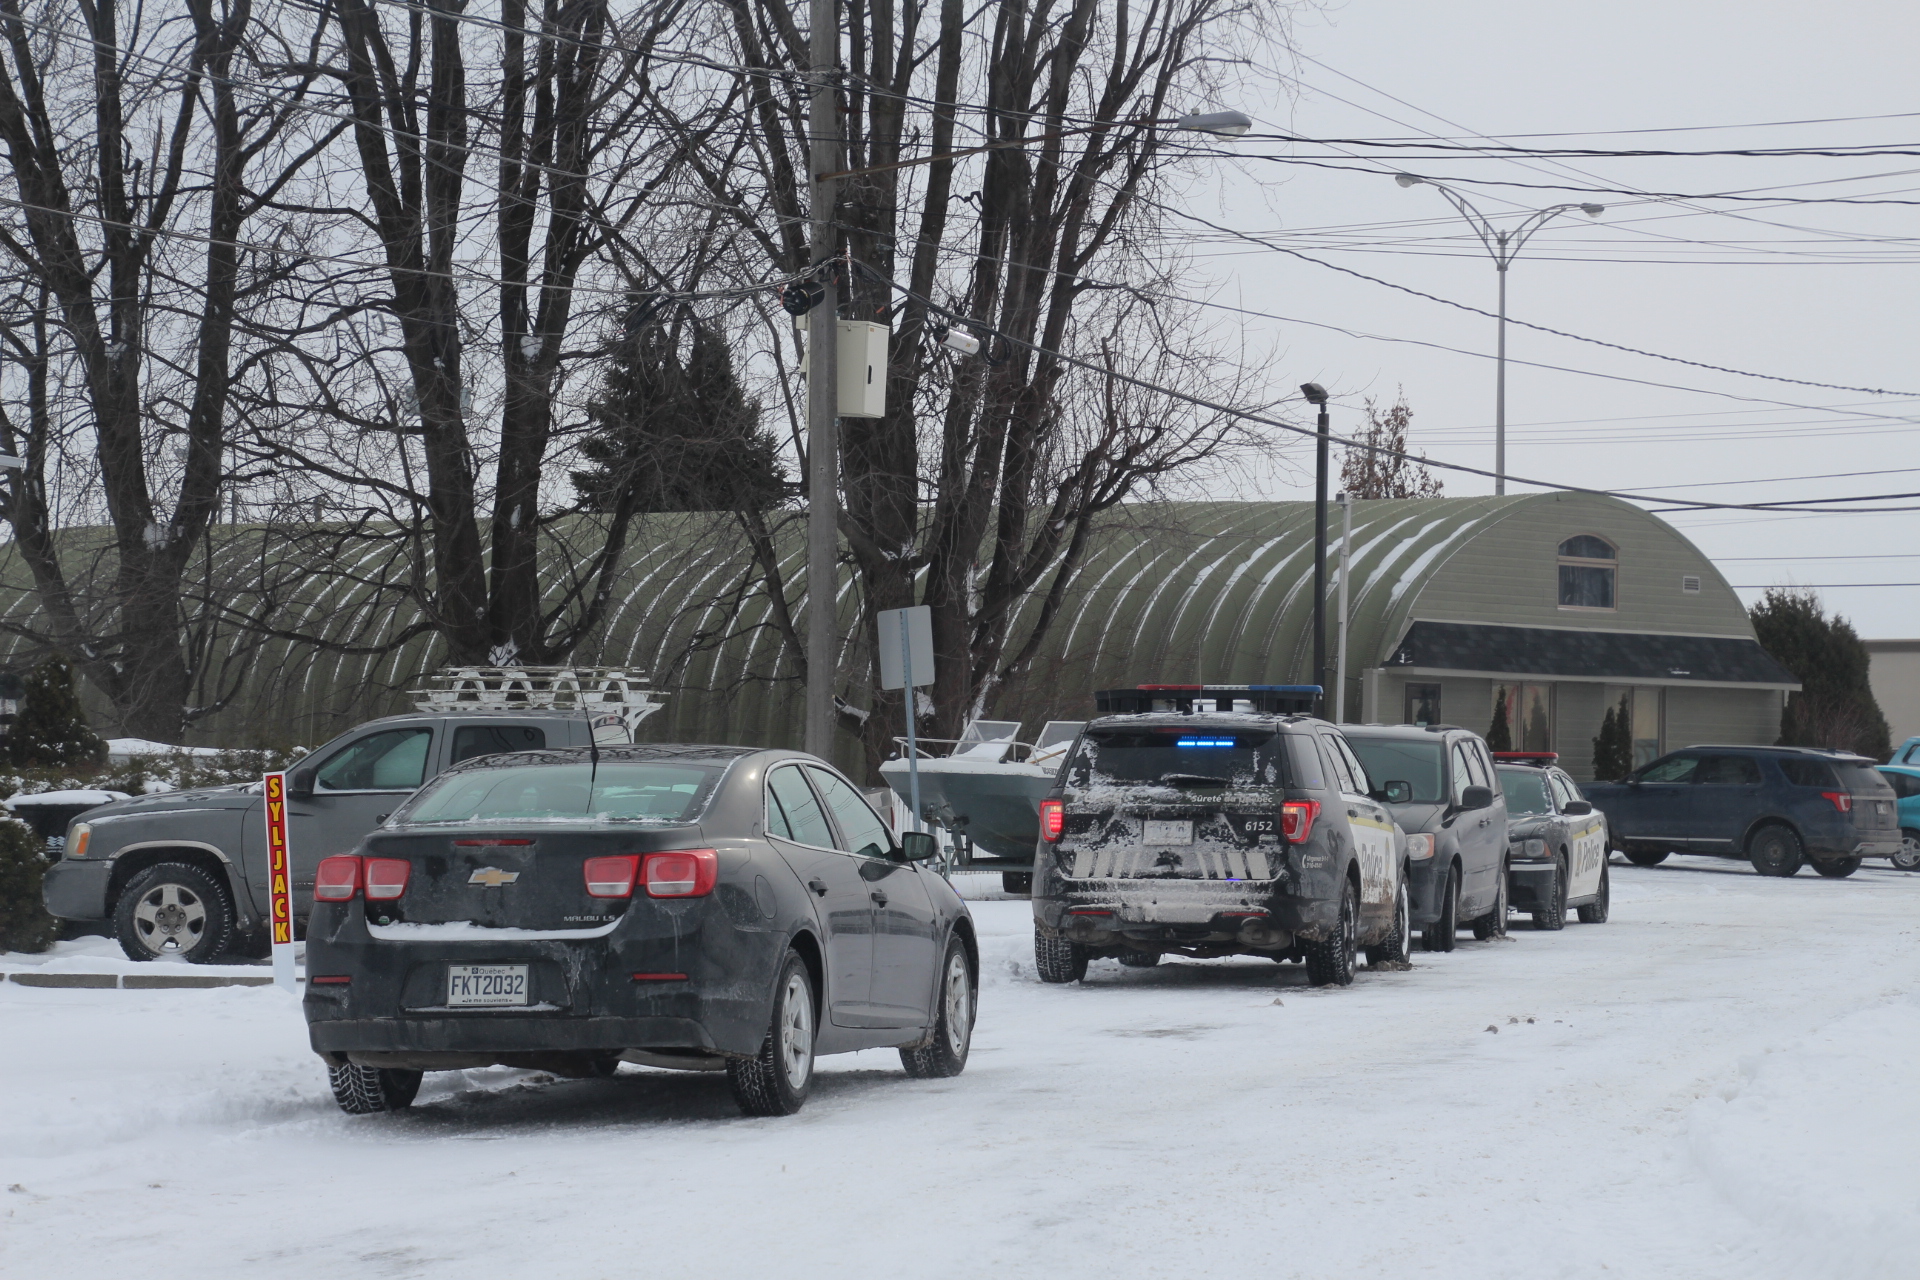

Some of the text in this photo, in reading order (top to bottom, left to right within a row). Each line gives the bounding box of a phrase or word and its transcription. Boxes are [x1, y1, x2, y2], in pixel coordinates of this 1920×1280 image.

[1191, 795, 1222, 803] Sûreté
[1245, 821, 1273, 831] 6152
[268, 777, 289, 943] SYLJACK
[1580, 839, 1600, 873] Police
[602, 914, 616, 922] LS
[478, 967, 506, 975] Québec
[451, 974, 524, 996] FKT2032
